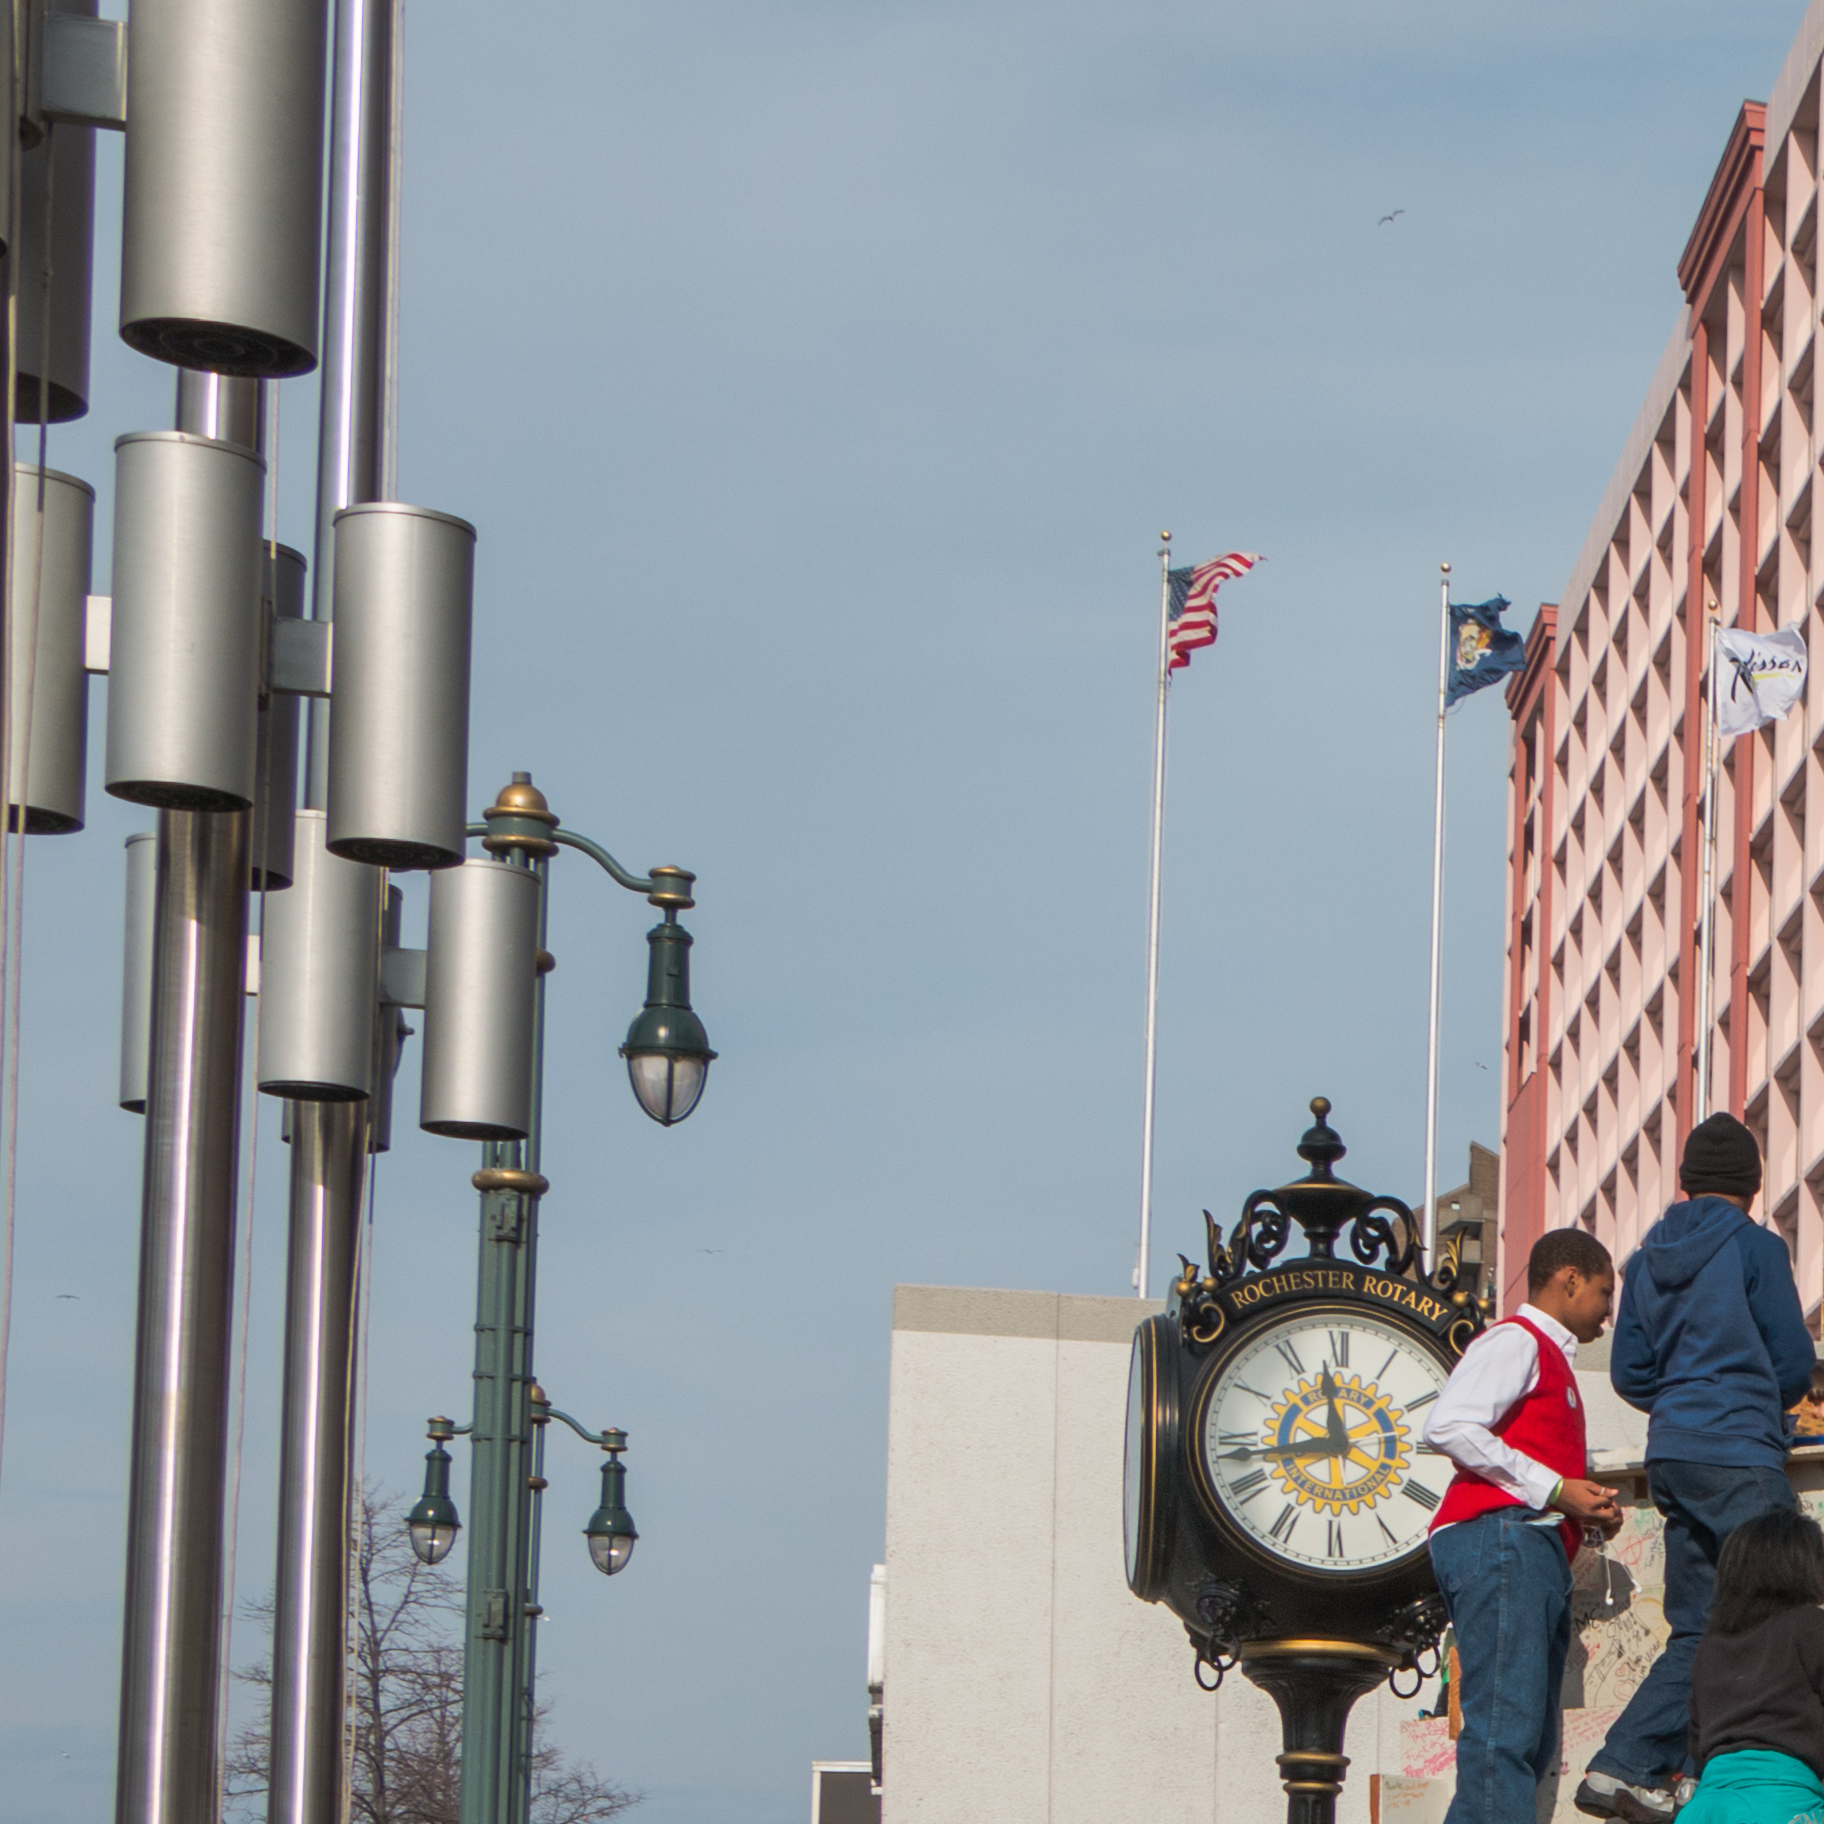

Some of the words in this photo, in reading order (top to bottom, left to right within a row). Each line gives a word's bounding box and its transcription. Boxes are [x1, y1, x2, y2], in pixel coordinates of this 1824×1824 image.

[1231, 1270, 1354, 1310] ROCHESTER
[1363, 1275, 1449, 1322] ROTARY
[1307, 1389, 1370, 1407] ROARY
[1286, 1462, 1391, 1501] INTERNATIONAL
